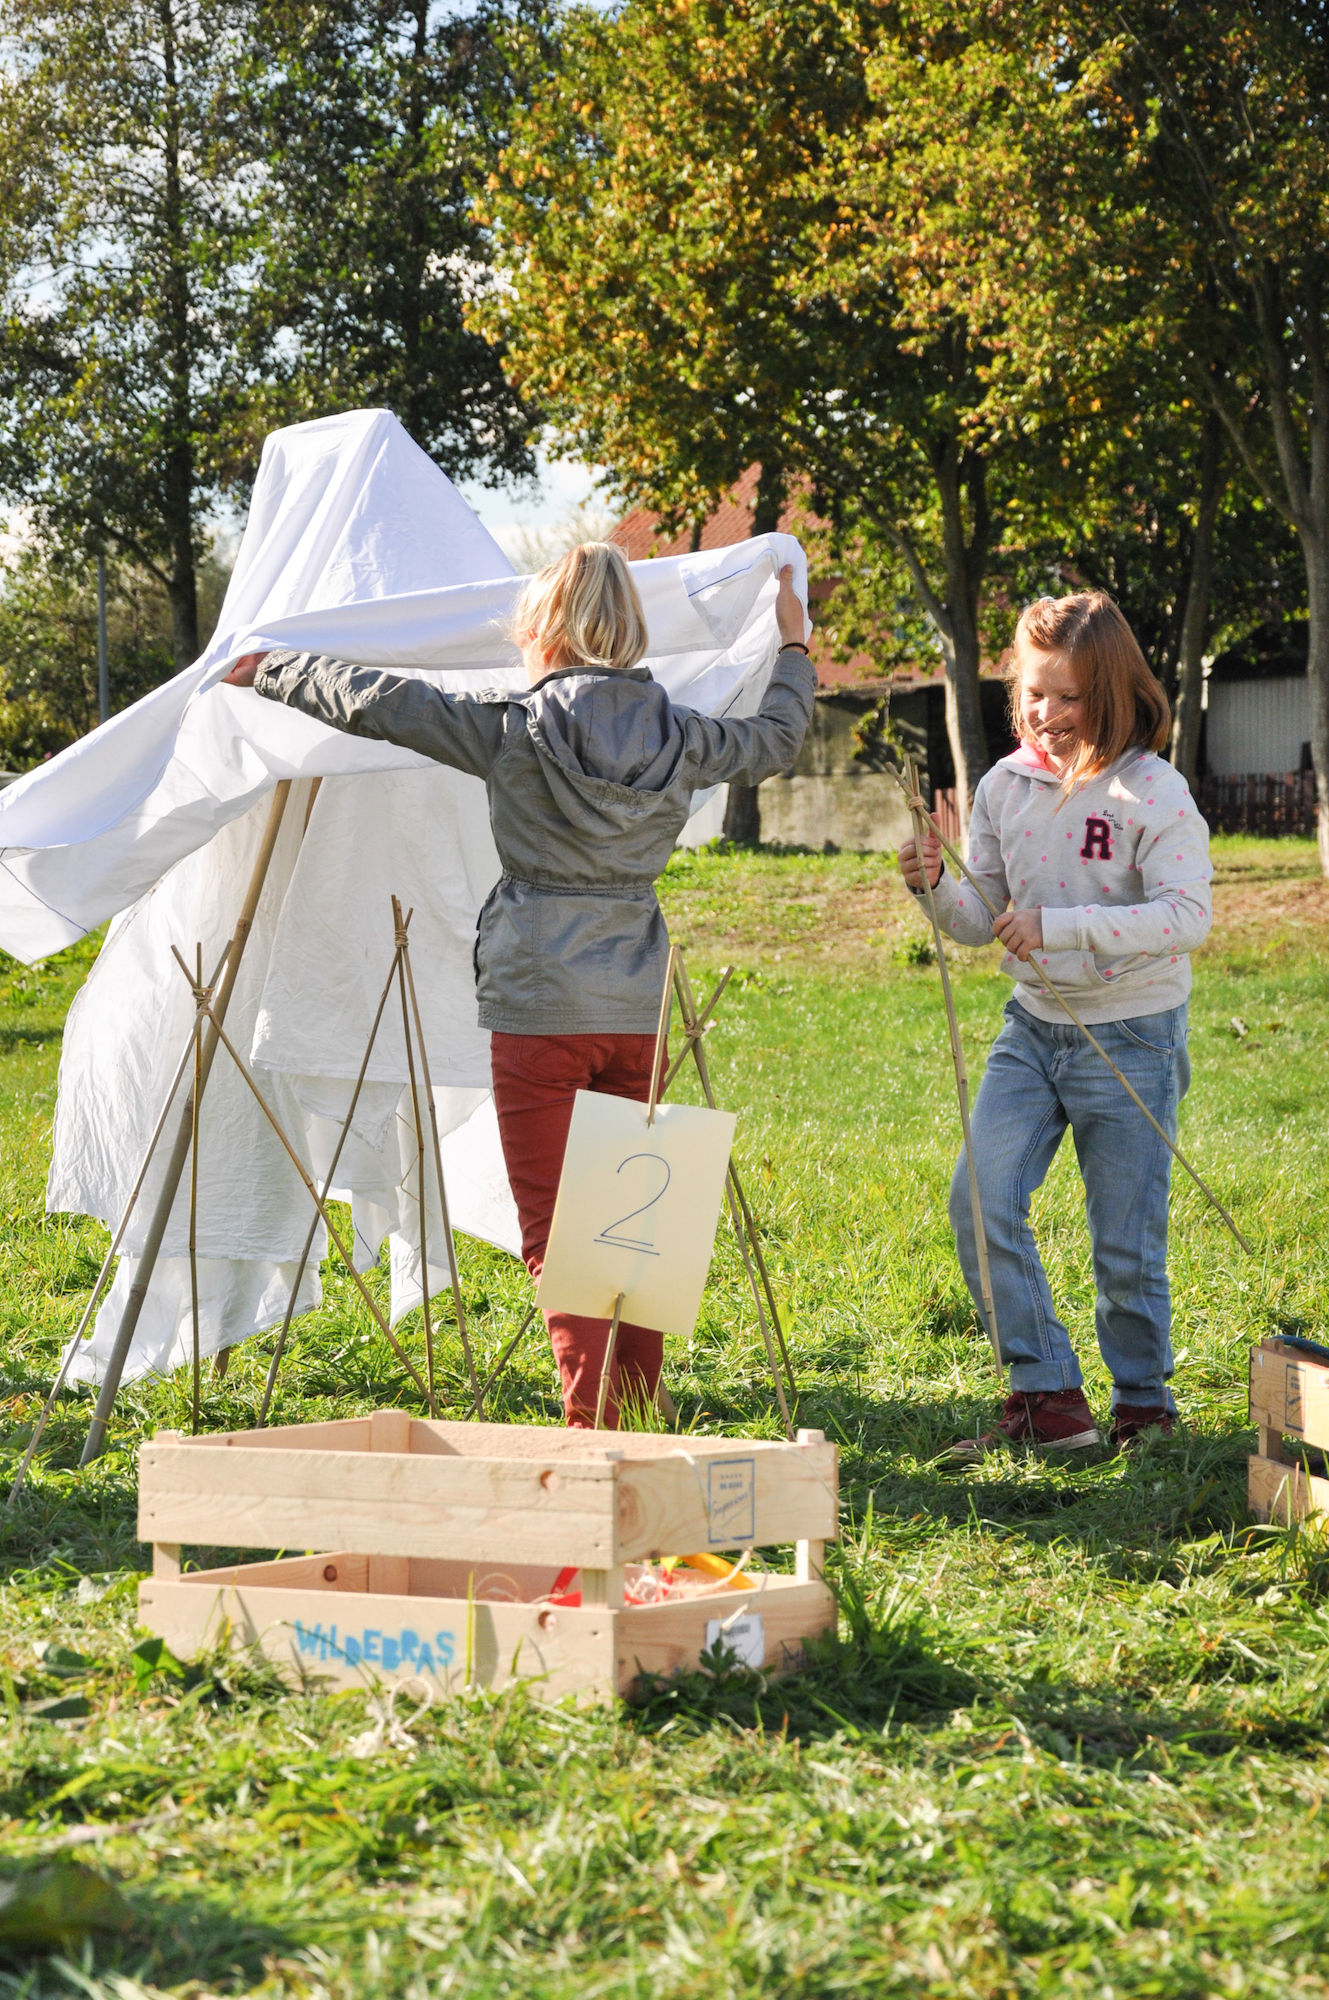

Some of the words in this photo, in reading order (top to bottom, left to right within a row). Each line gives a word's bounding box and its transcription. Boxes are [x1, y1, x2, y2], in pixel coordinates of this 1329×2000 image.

[1080, 817, 1112, 860] R
[600, 1153, 671, 1247] 2
[293, 1619, 455, 1676] WILDEBRAS
